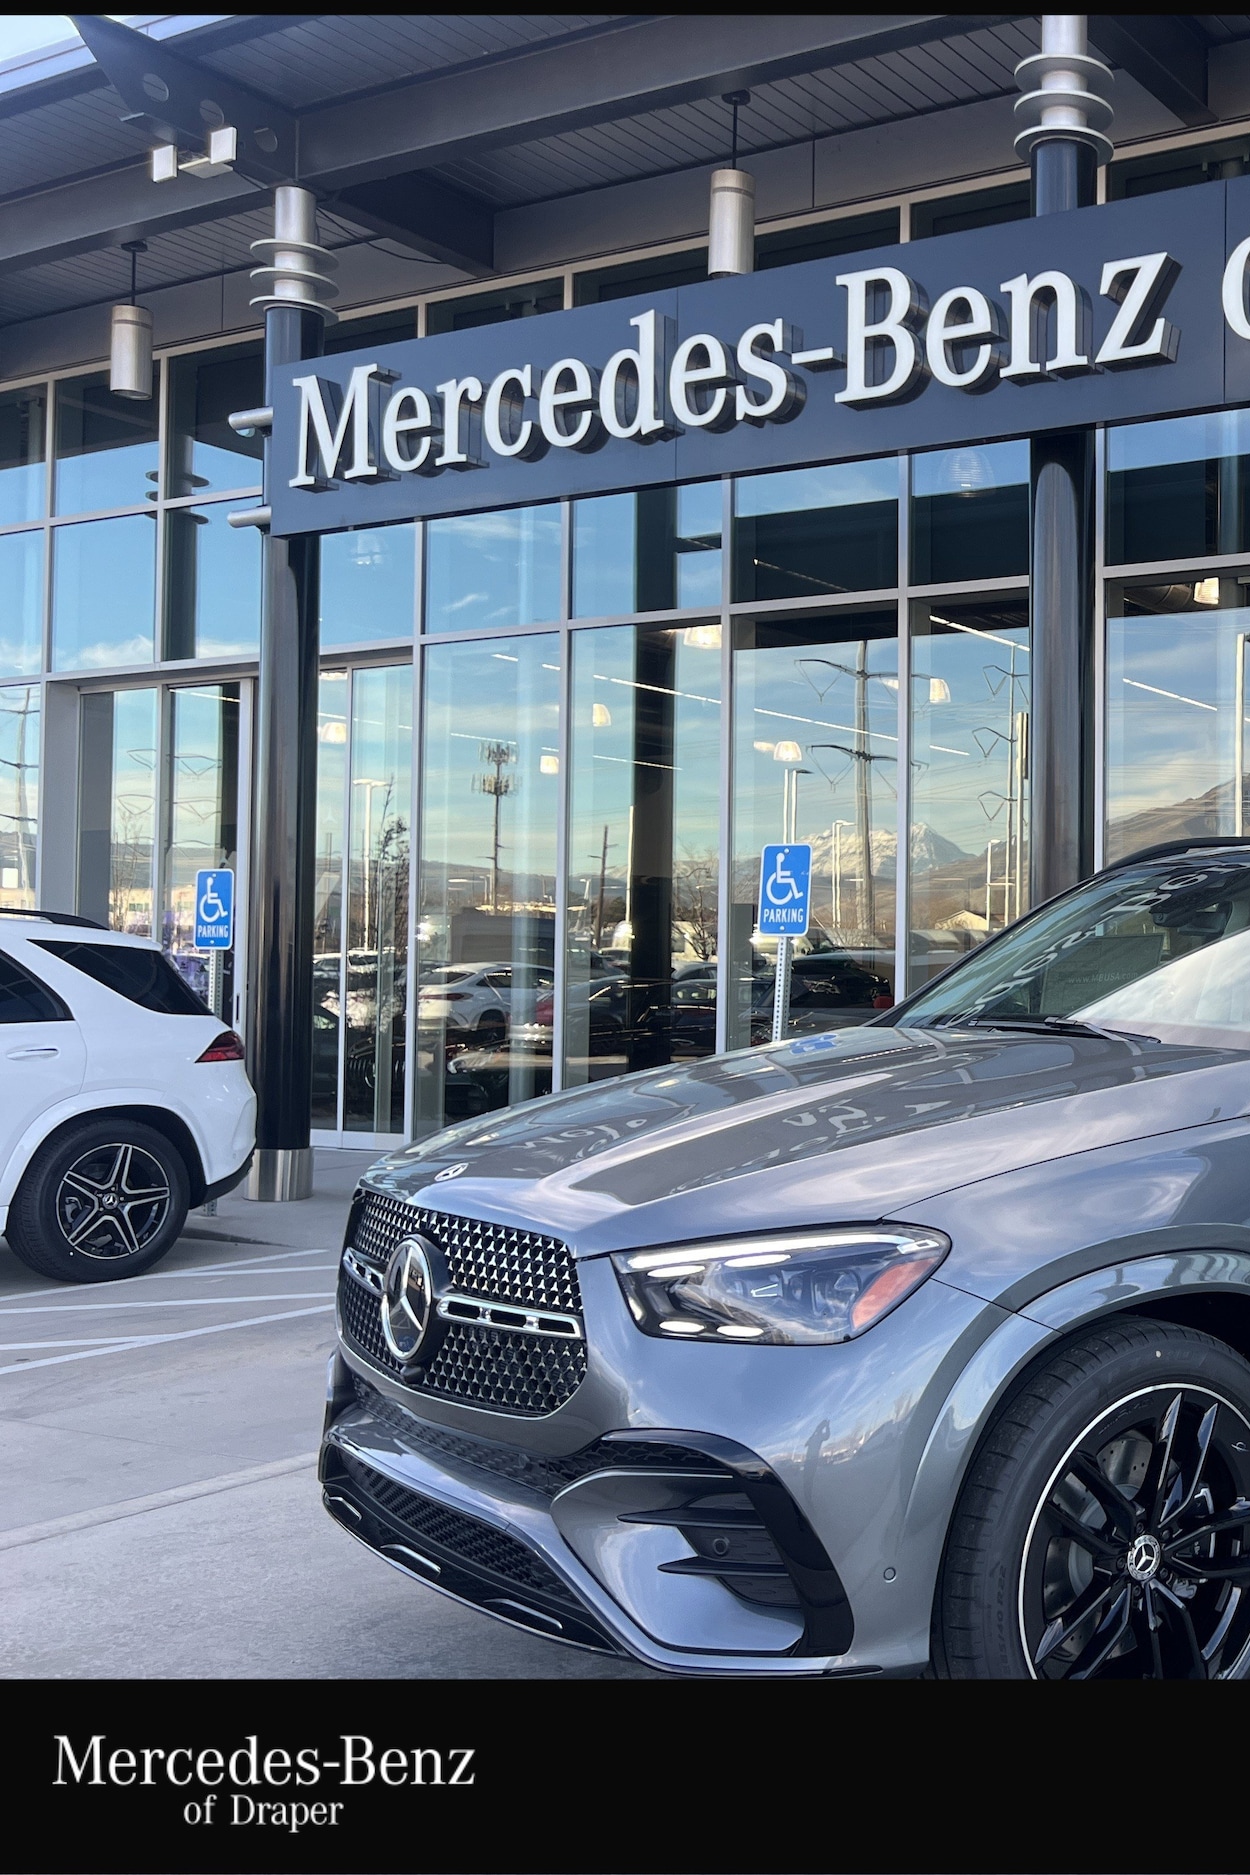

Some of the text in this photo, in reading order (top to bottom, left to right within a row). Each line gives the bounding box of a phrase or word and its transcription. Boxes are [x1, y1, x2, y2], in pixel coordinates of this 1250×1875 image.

[288, 251, 1176, 488] Mercedes-Benz
[763, 908, 803, 922] PARKING
[197, 925, 228, 938] PARKING
